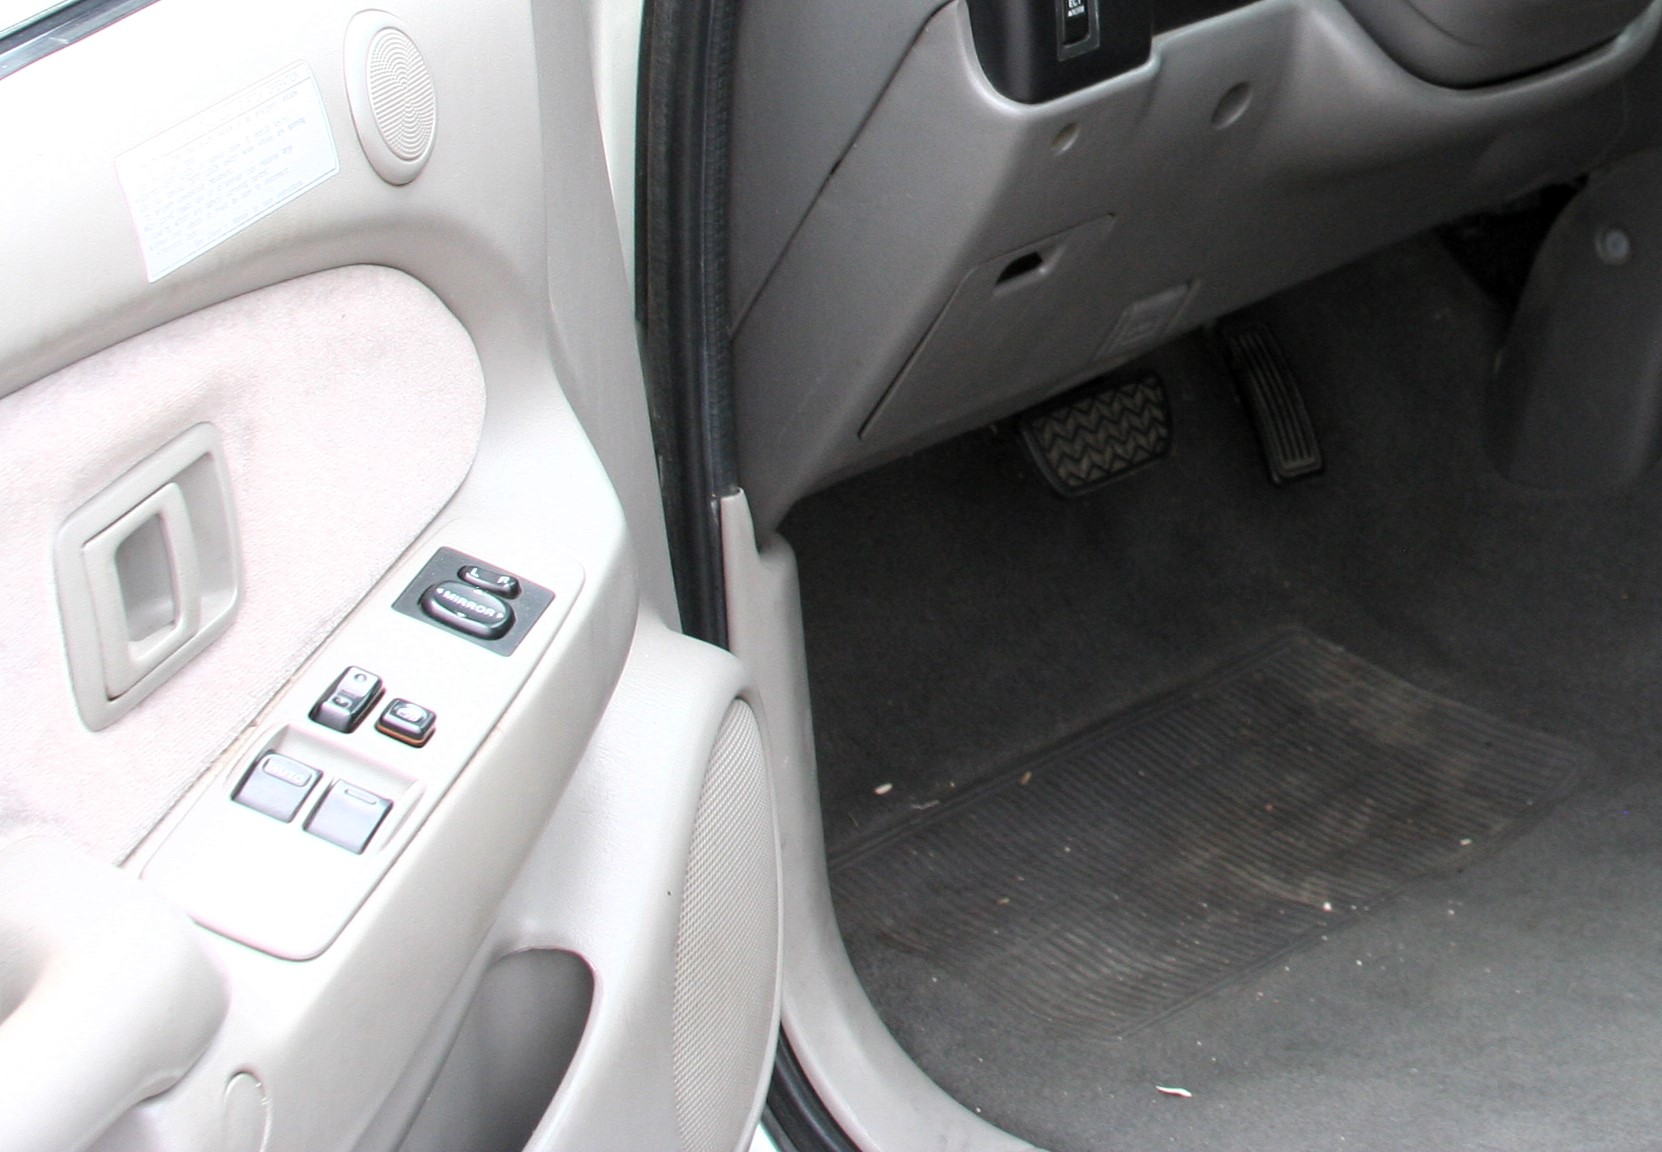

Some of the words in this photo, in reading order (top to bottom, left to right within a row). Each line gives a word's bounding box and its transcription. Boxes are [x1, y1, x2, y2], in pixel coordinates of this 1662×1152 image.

[470, 567, 480, 577] L
[496, 576, 511, 587] R
[442, 590, 497, 617] MIRROR
